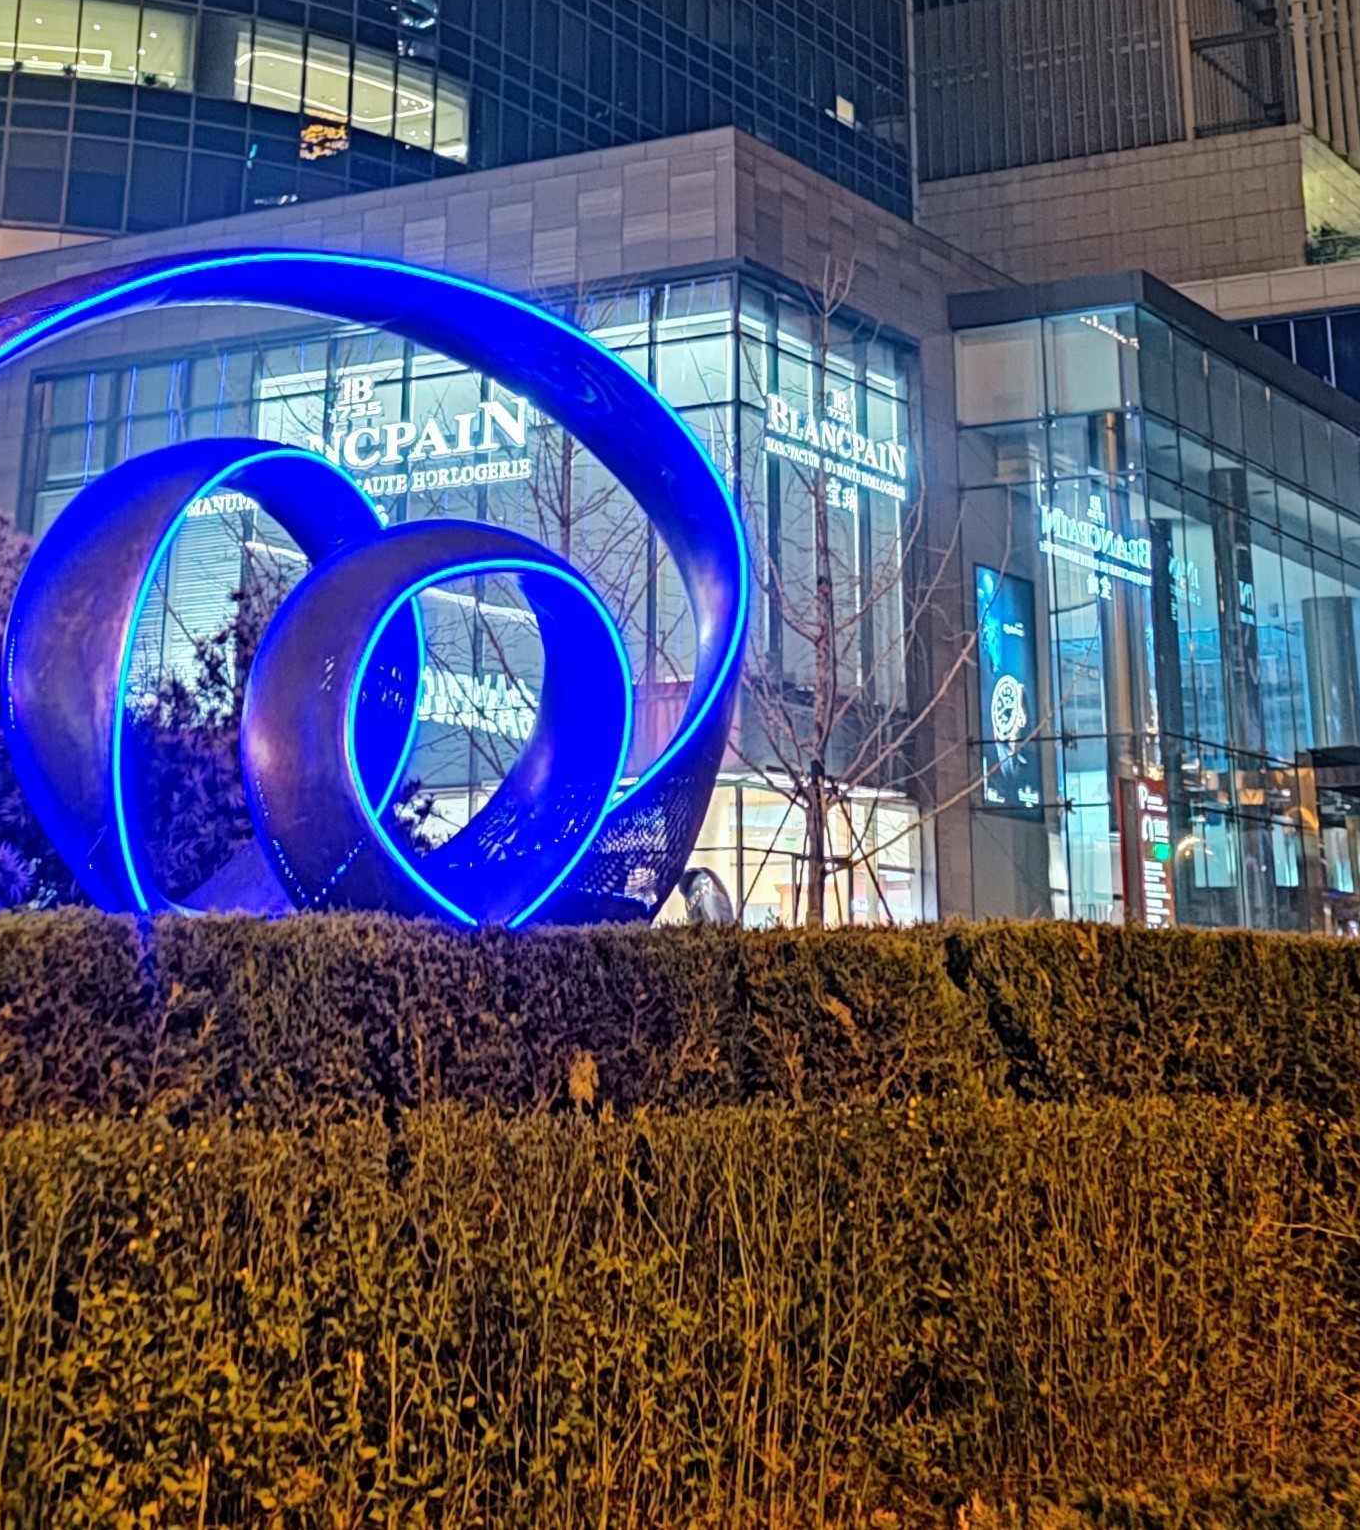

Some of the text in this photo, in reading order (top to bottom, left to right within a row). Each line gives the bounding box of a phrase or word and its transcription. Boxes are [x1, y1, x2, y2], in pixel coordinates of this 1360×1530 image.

[304, 396, 529, 469] NCPAIN
[328, 401, 383, 423] 1735
[766, 393, 906, 480] BLANCPAIN
[356, 473, 407, 497] AUTE
